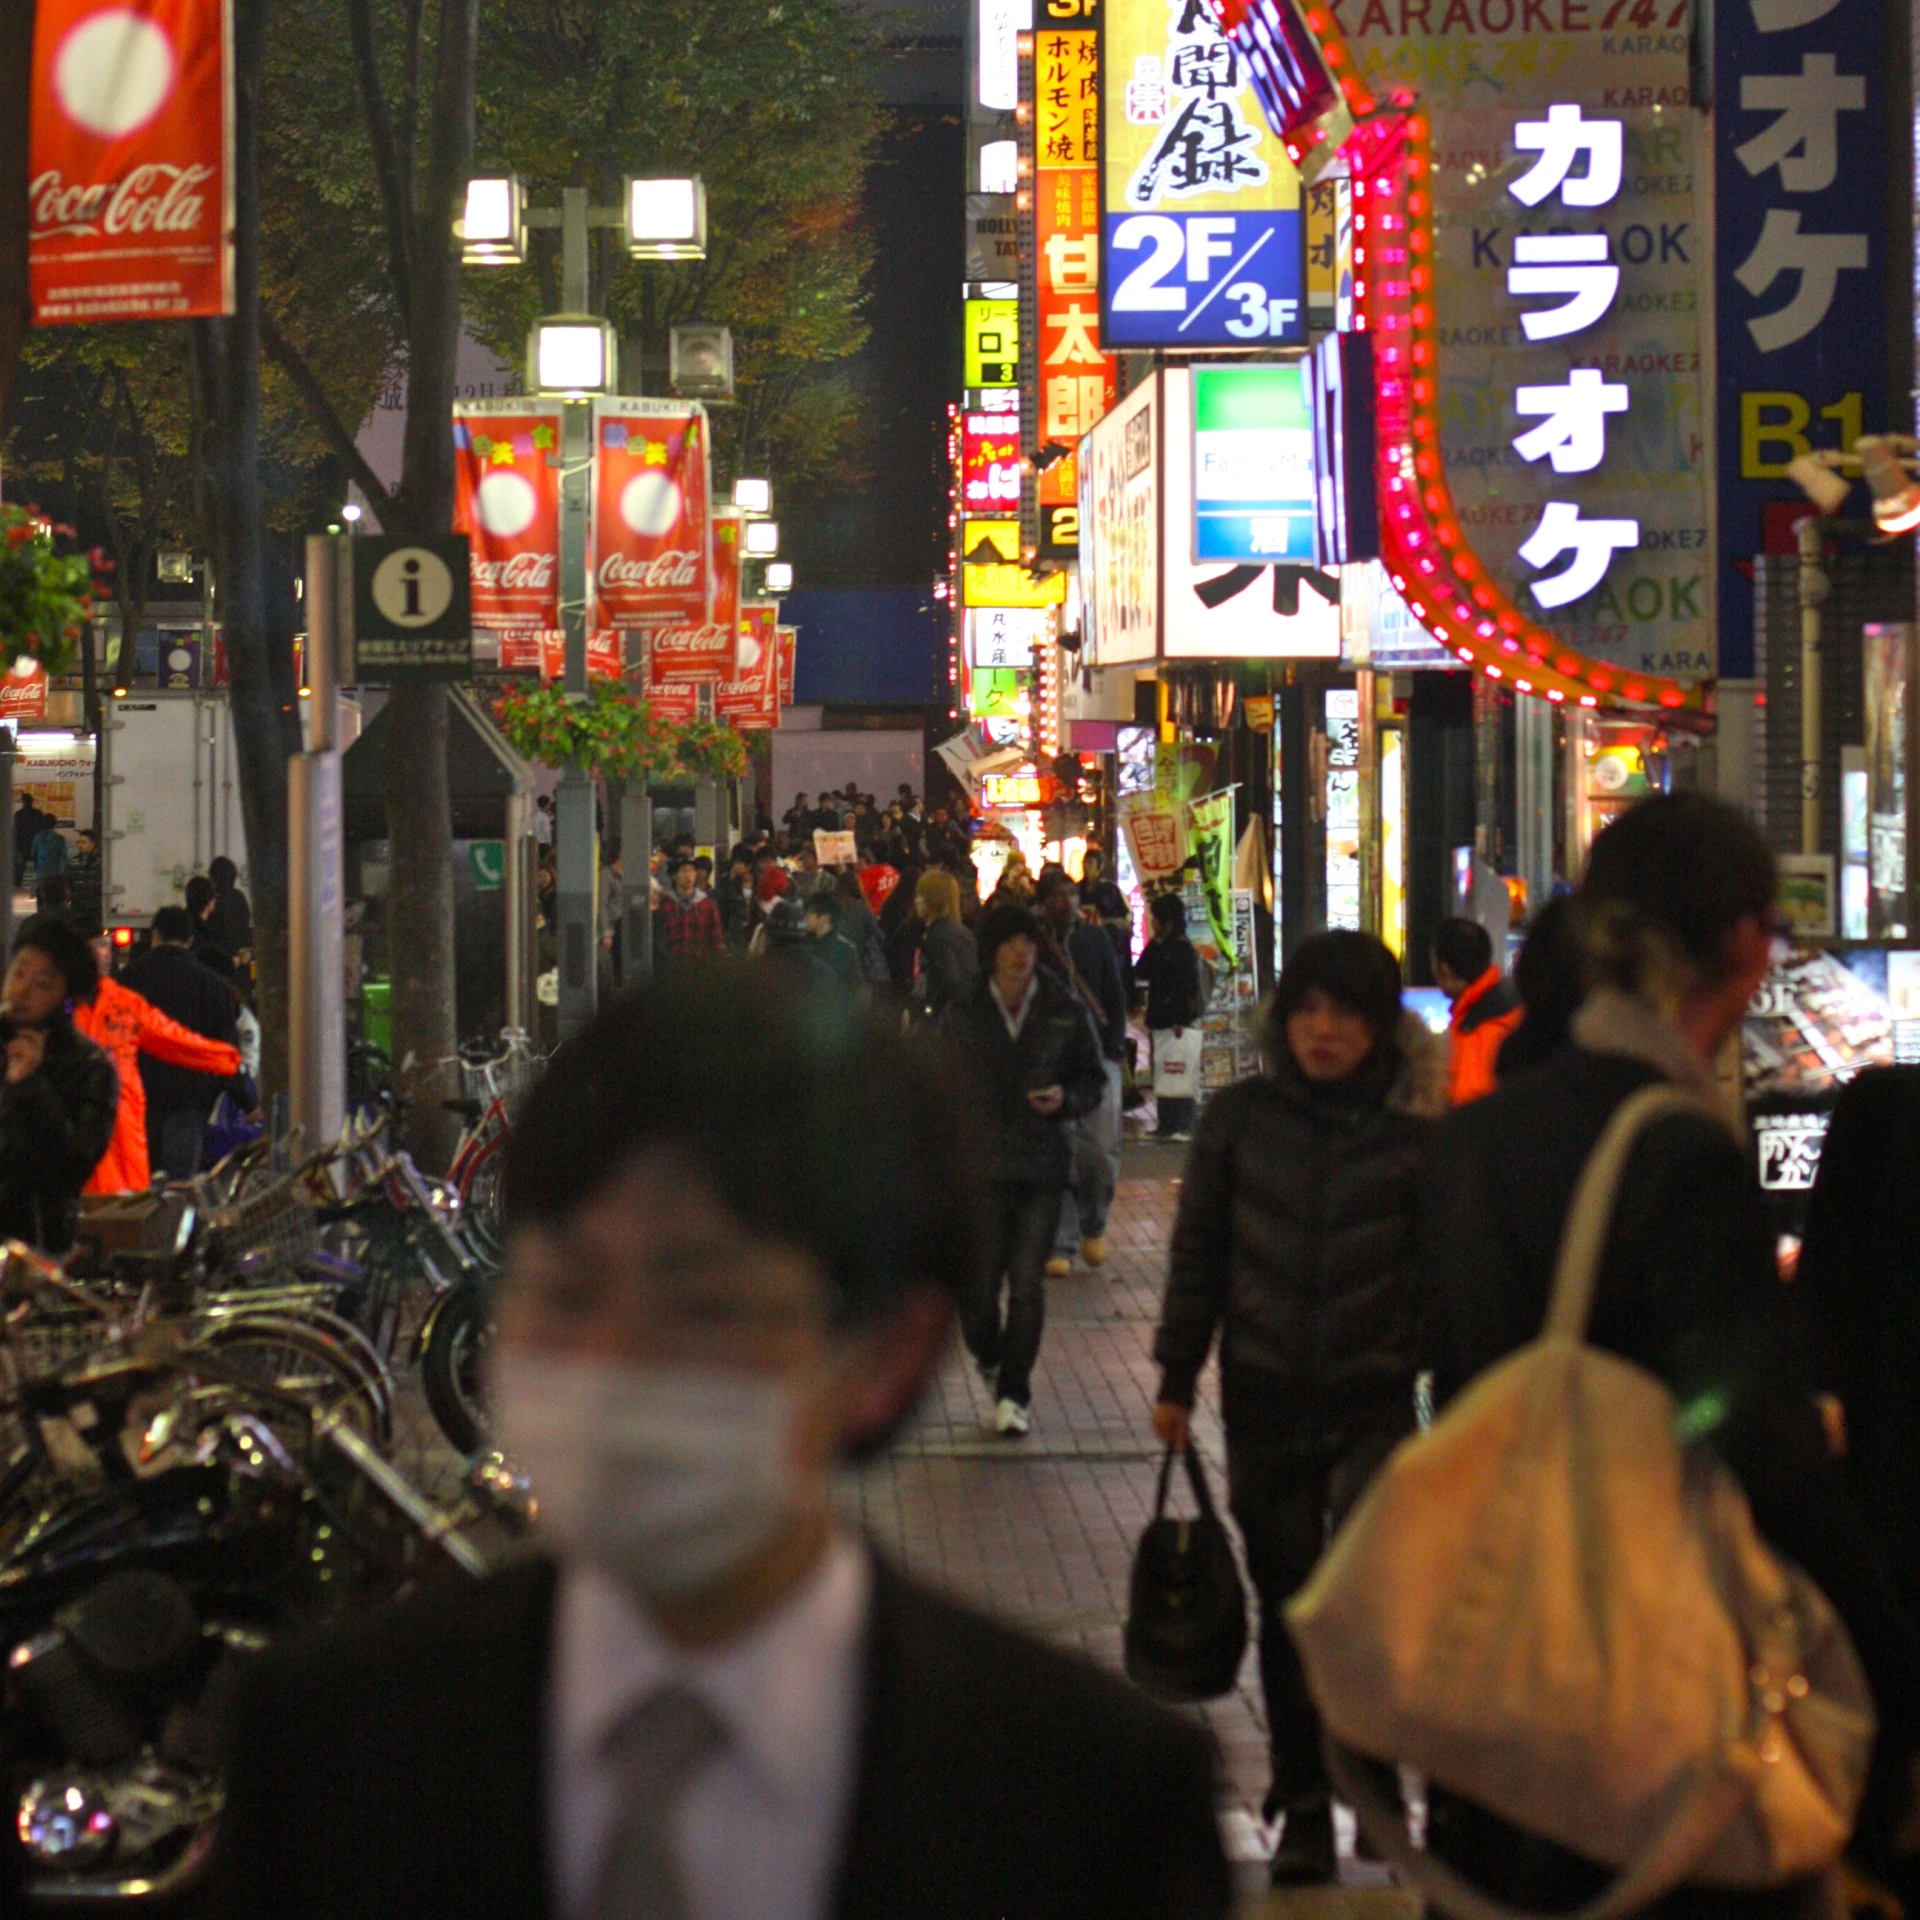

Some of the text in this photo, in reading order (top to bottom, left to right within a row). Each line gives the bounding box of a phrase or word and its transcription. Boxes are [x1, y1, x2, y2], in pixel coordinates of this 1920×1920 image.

[1046, 36, 1075, 161] ホルモン焼
[1044, 233, 1106, 436] 甘太郎
[1506, 103, 1639, 610] カラオケ
[1741, 392, 1863, 478] B1
[470, 552, 556, 589] oca-Cola
